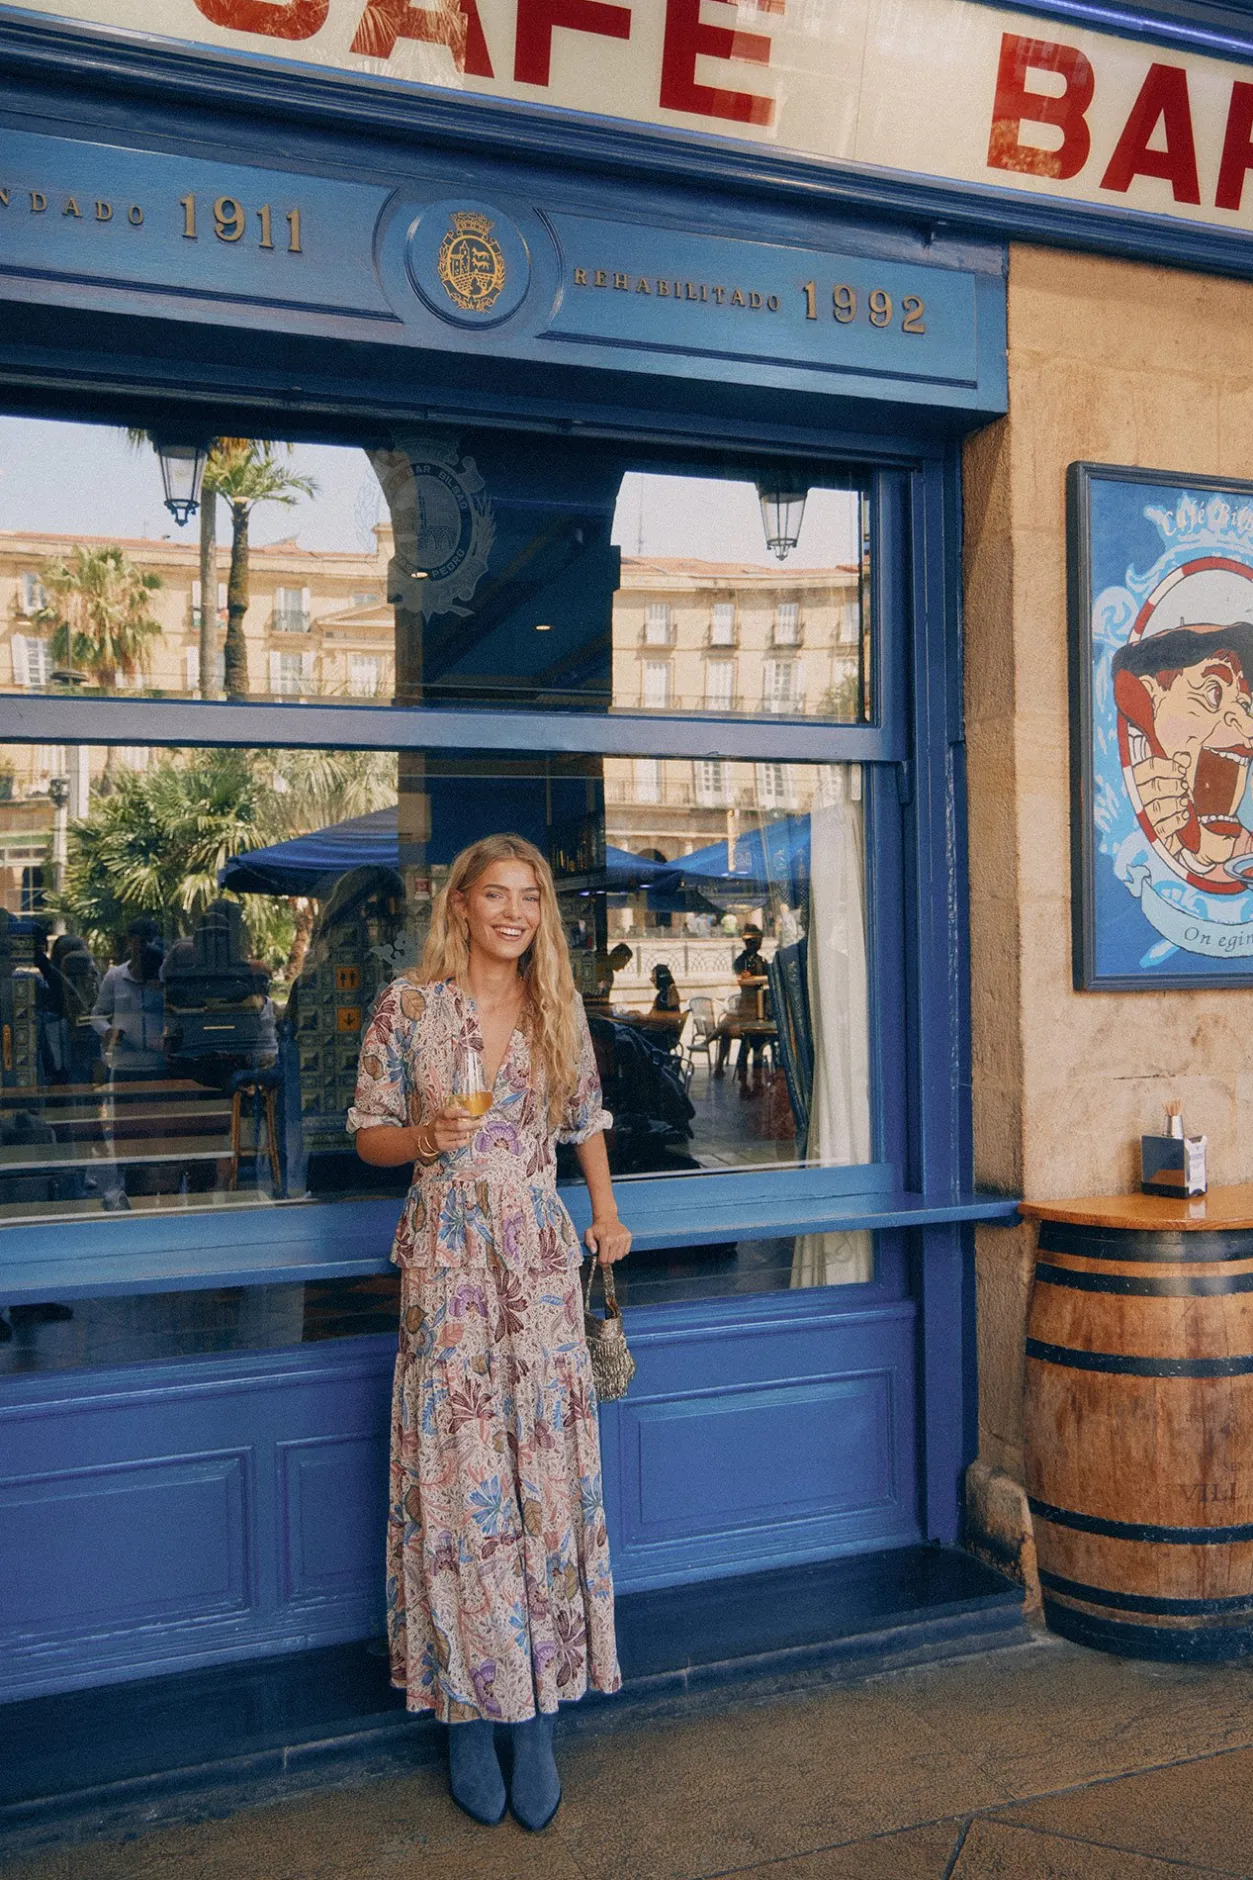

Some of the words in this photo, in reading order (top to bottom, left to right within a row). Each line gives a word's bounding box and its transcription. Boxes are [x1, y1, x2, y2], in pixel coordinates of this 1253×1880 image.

[193, 0, 776, 127] AFE
[180, 193, 303, 253] 1911
[574, 268, 781, 312] REHABILITADO
[803, 281, 925, 334] 1992
[438, 470, 468, 510] BILBAO
[1163, 500, 1205, 536] Café
[432, 549, 465, 579] PEDRO
[1184, 926, 1212, 945] On
